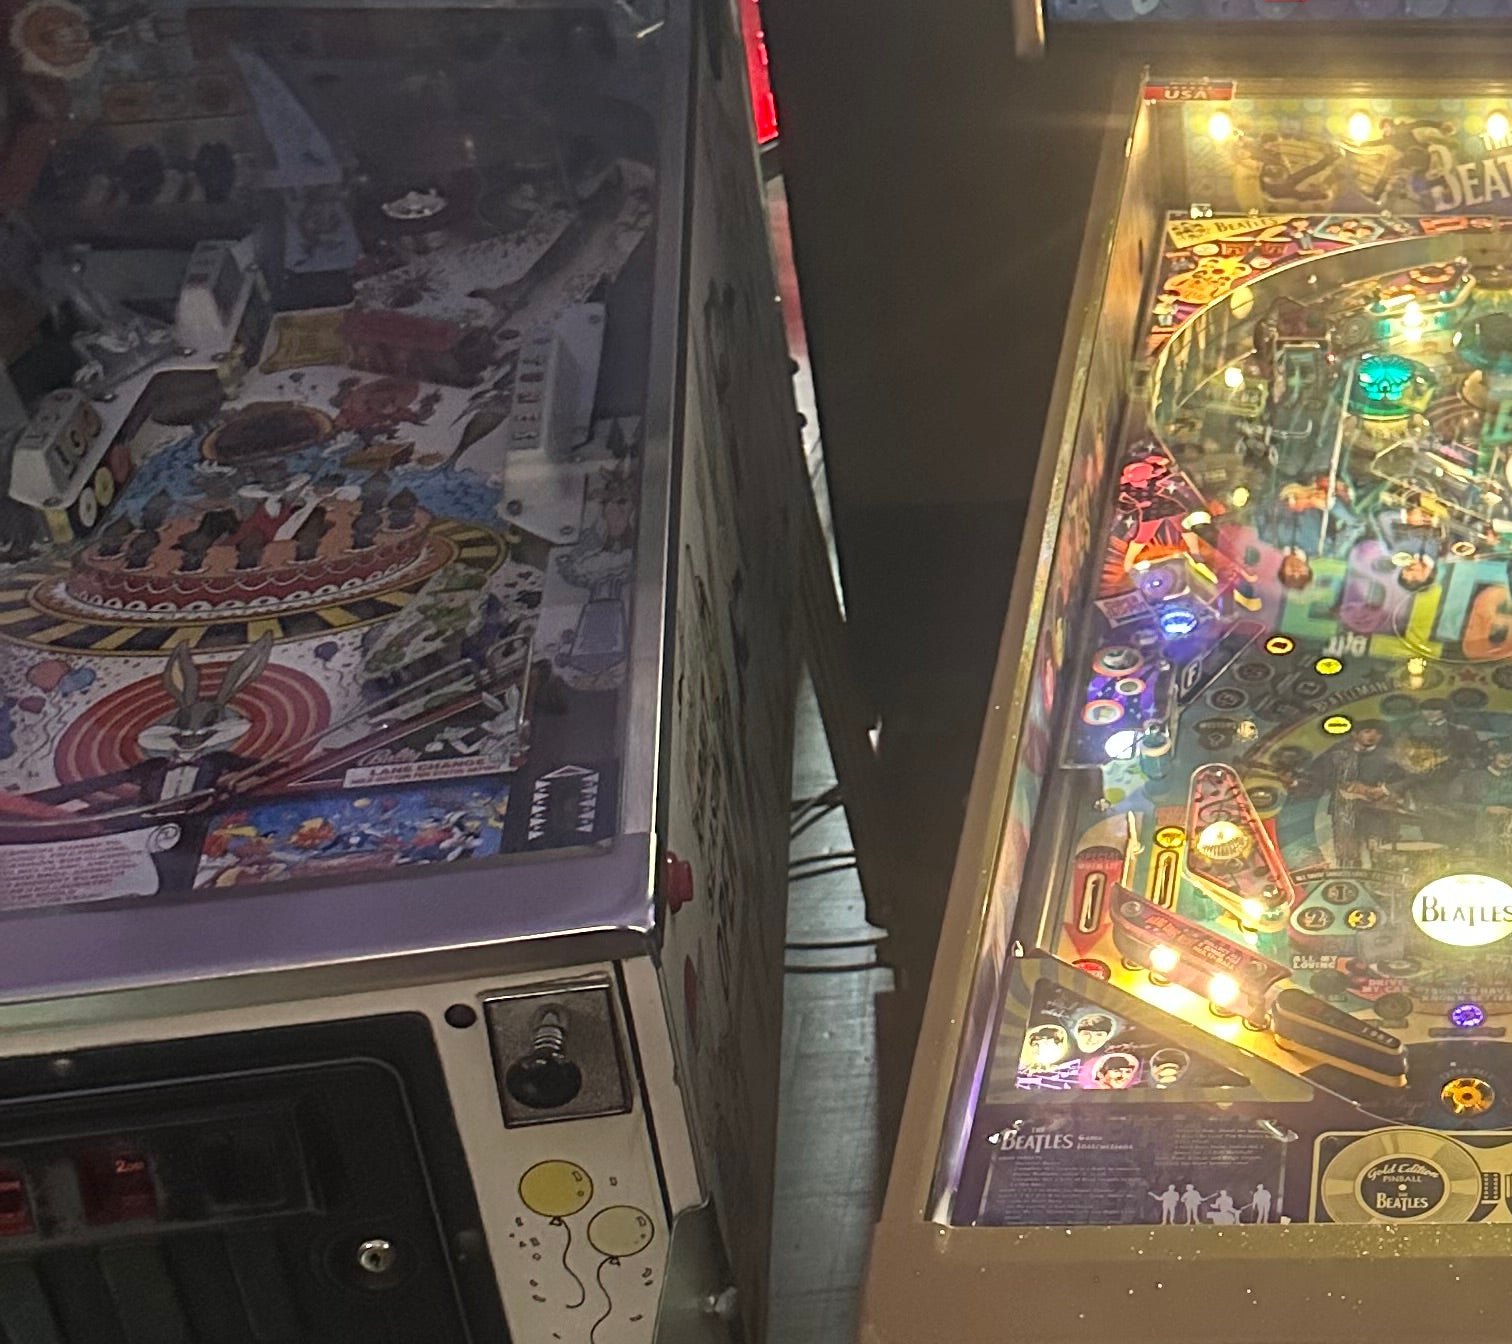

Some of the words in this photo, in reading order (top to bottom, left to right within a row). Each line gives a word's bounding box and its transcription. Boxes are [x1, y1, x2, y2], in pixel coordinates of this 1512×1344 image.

[1164, 89, 1209, 99] USA
[1213, 217, 1279, 234] BEATLES
[370, 764, 415, 776] LANE
[421, 758, 488, 772] CHANGE
[1292, 955, 1316, 963] ALL
[1319, 955, 1338, 963] MY
[1000, 1129, 1075, 1153] BEATLES
[1078, 1135, 1104, 1143] Game
[1366, 1163, 1397, 1181] Gold
[1397, 1162, 1440, 1180] Edition
[1382, 1174, 1423, 1184] PINBALL
[1376, 1191, 1429, 1211] BEATLES
